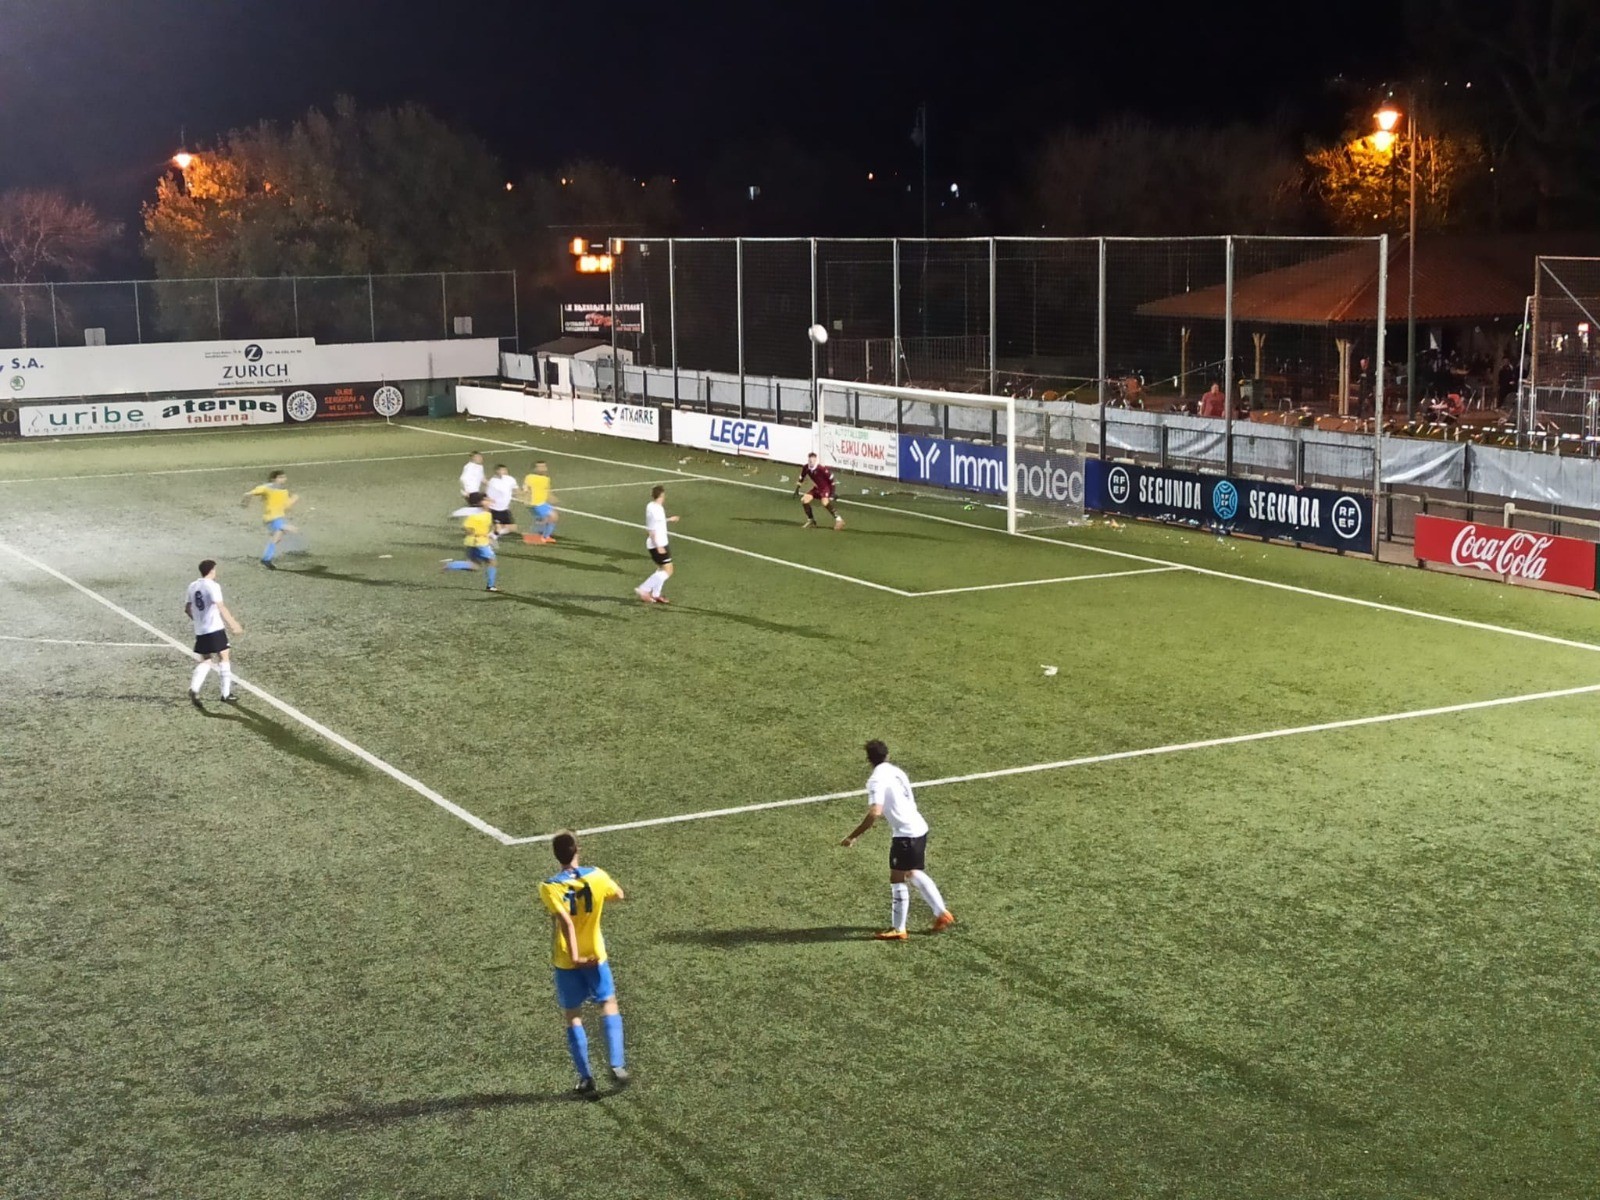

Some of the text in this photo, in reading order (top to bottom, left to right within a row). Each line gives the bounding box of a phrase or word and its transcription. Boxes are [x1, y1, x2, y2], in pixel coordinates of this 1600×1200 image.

[11, 357, 45, 369] S.A.
[223, 363, 288, 379] ZURICH
[49, 406, 144, 426] uribe
[162, 399, 278, 418] aterpe
[187, 413, 249, 424] taberna
[619, 407, 654, 425] ATXARRE
[710, 418, 769, 450] LEGEA
[841, 440, 860, 456] ESKU
[861, 442, 885, 460] ONAK
[950, 444, 1083, 502] Immunotec
[1139, 474, 1201, 510] SEGUNDA
[1249, 489, 1320, 528] SEGUNDA
[1451, 524, 1554, 580] Coca-Cola
